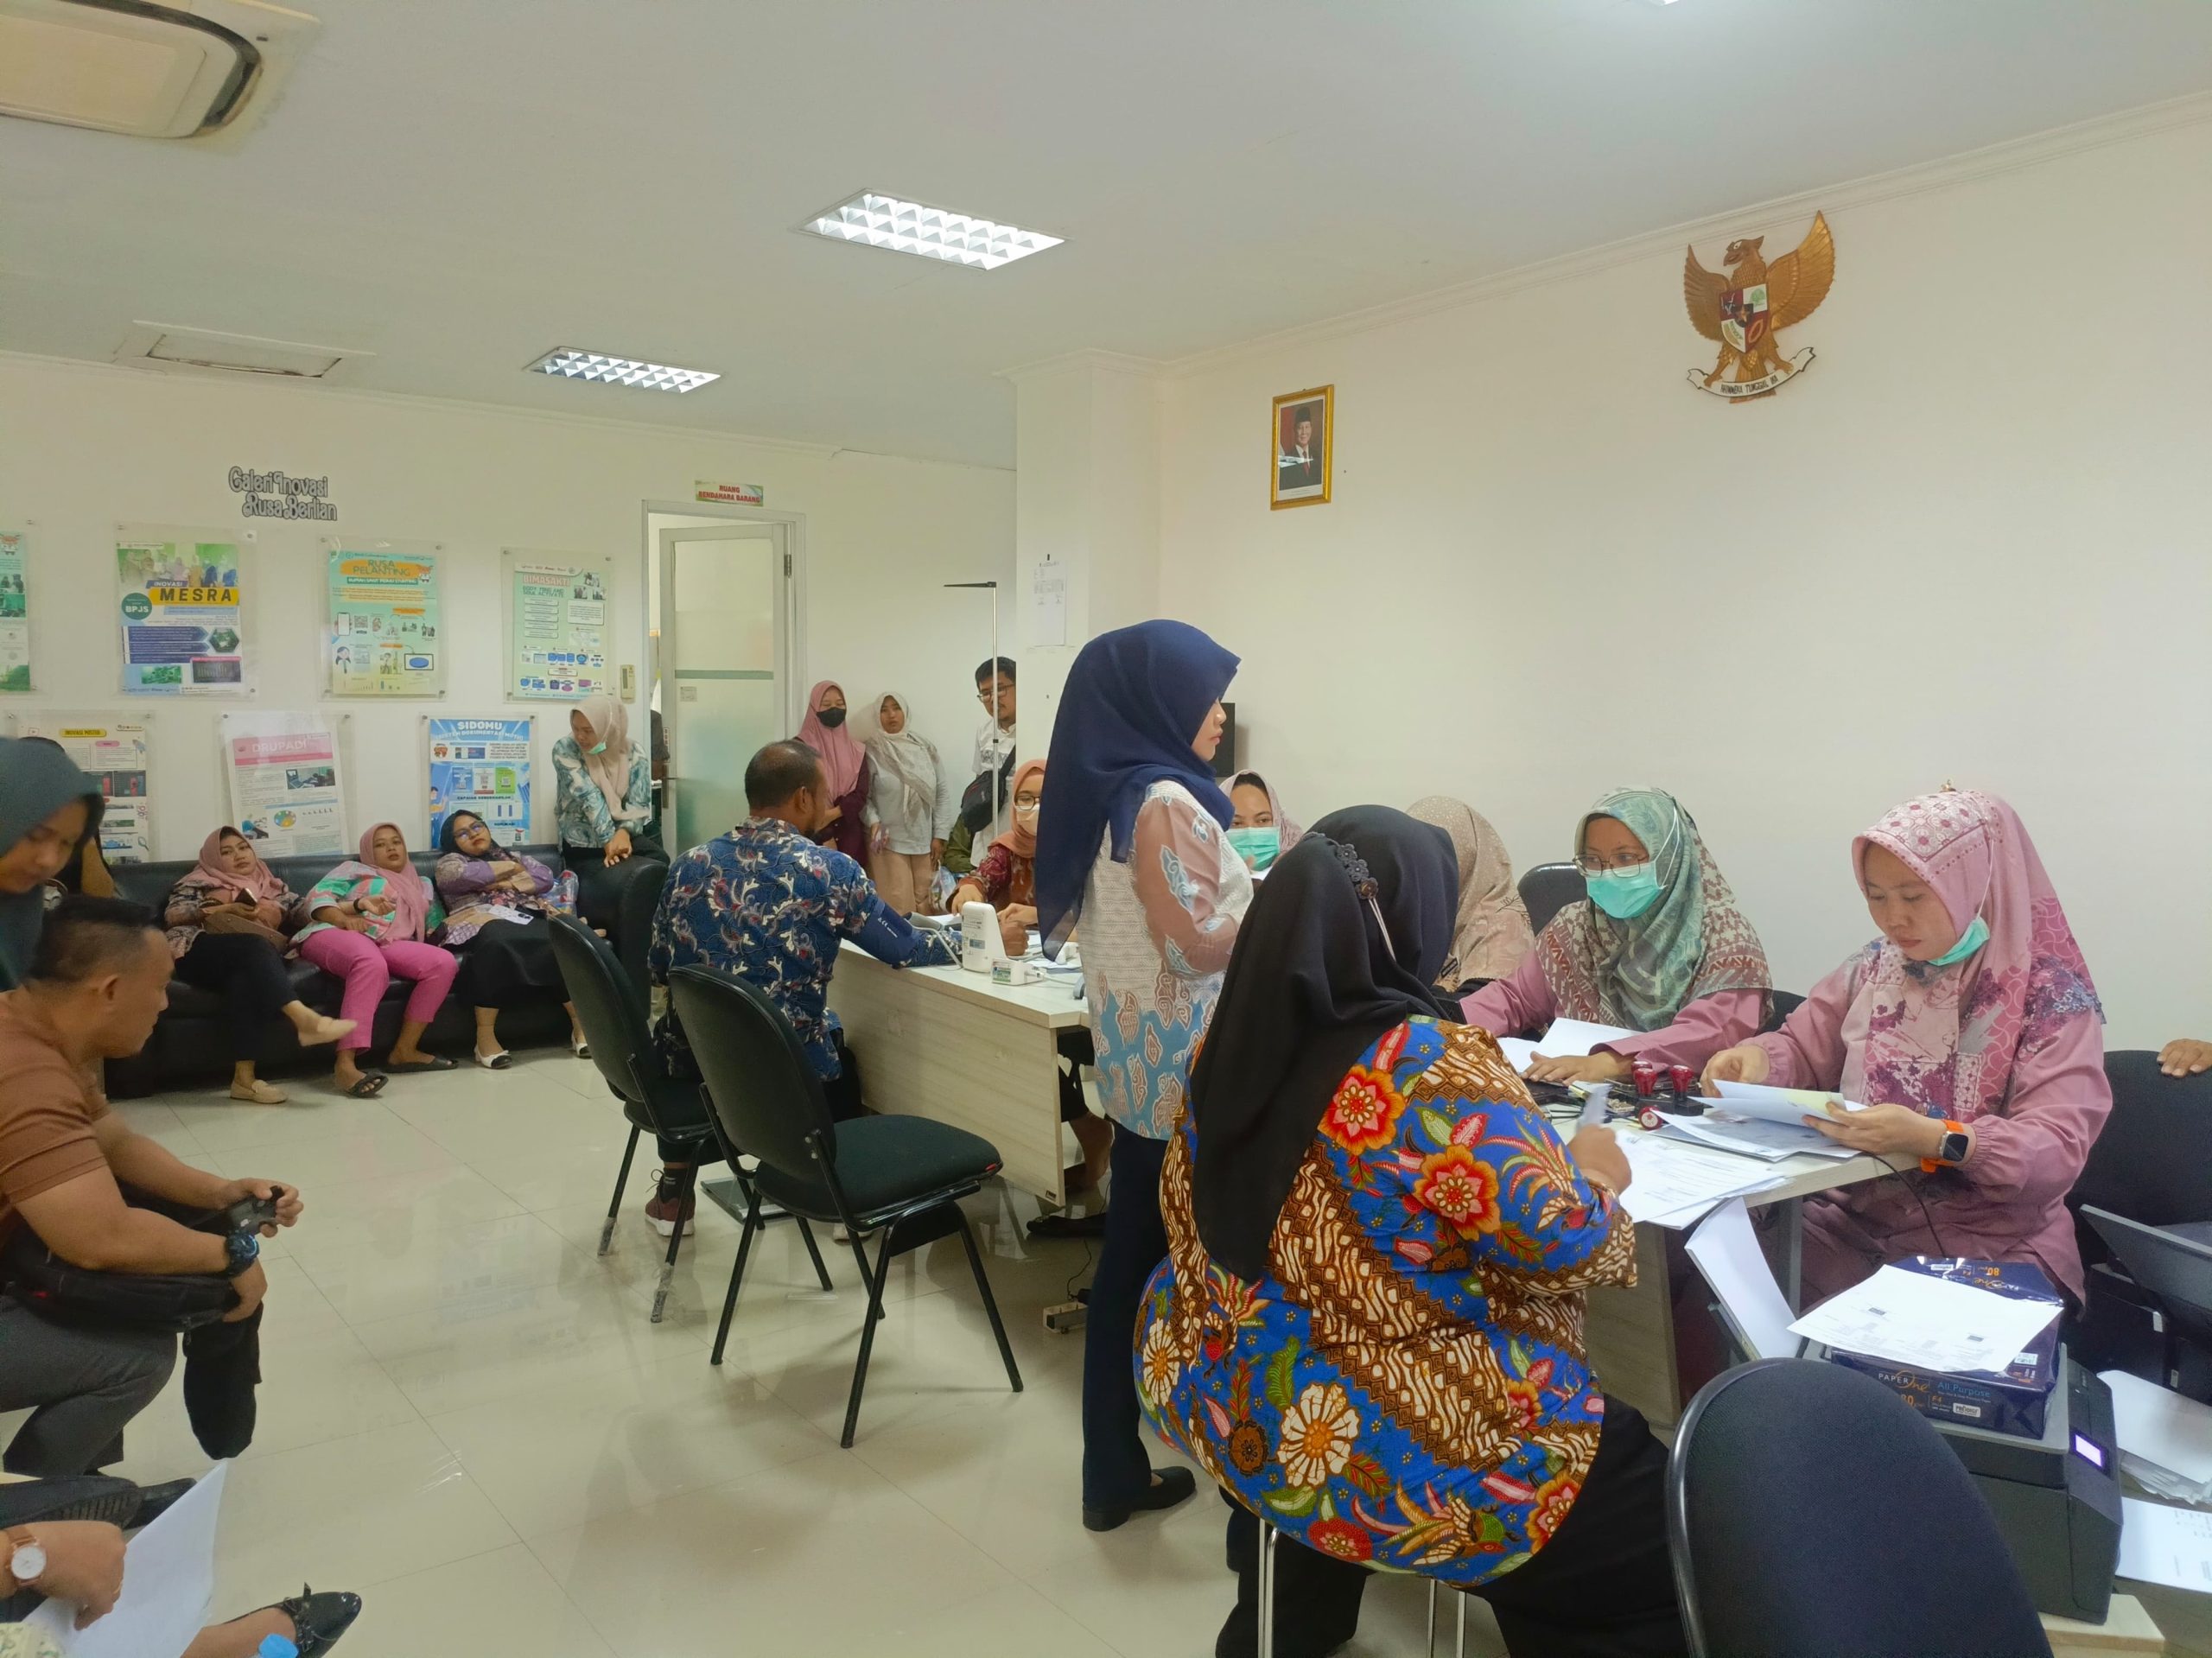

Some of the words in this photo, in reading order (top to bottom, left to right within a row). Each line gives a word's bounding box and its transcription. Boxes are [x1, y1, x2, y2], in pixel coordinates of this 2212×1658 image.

[228, 466, 274, 493] Galeri
[273, 471, 328, 498] Inovasi
[719, 485, 741, 493] RUANG
[242, 491, 283, 518] Rusa
[283, 493, 338, 521] Berlian
[353, 566, 411, 576] PELANTING
[160, 588, 232, 602] MESRA
[457, 721, 503, 730] SIDOMU
[252, 740, 307, 753] DRUPADI
[1878, 1373, 1909, 1384] PAPER
[1937, 1382, 1950, 1391] All
[1953, 1383, 1991, 1398] Purpose
